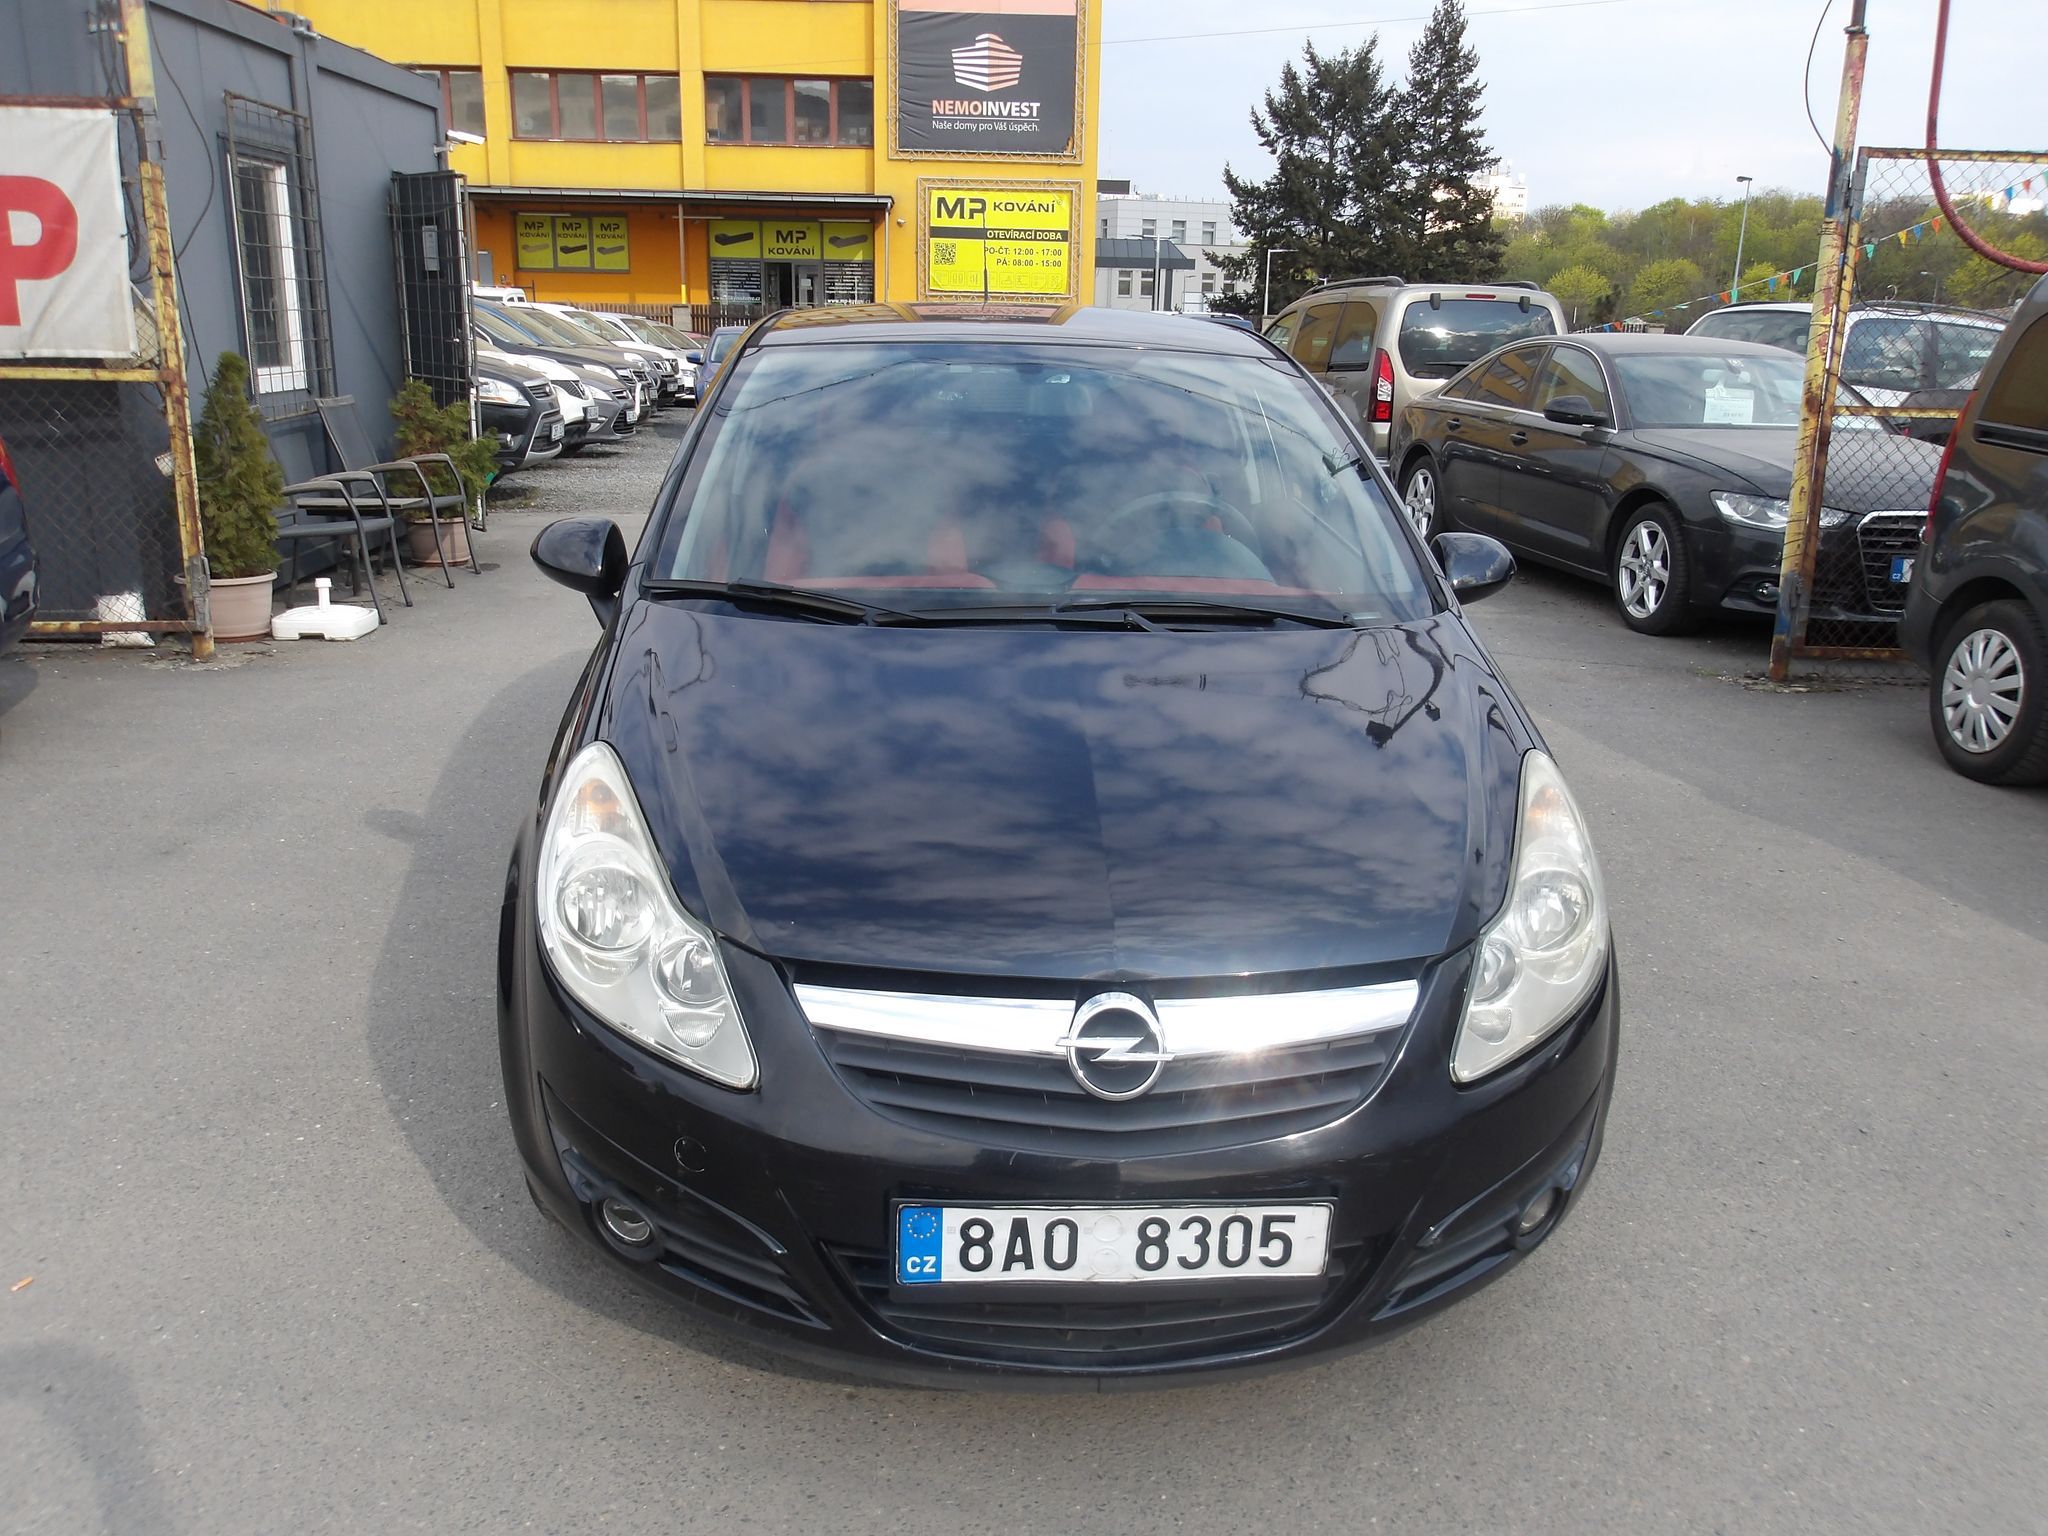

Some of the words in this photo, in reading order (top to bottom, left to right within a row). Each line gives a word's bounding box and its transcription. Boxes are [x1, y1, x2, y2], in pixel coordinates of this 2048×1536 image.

[932, 100, 1041, 117] NEMOINVEST
[932, 120, 953, 130] Naše
[953, 120, 978, 132] domy
[978, 123, 993, 132] pro
[993, 121, 1007, 131] Váš
[1008, 121, 1040, 133] úspěch.
[936, 196, 987, 220] MP
[993, 199, 1056, 213] KOVÁNÍ
[524, 221, 545, 231] MP
[562, 222, 583, 232] MP
[600, 223, 621, 233] MP
[775, 230, 807, 244] MP
[986, 229, 1035, 240] OTEVÍRACÍ
[1036, 232, 1063, 241] DOBA
[767, 246, 815, 256] KOVÁNÍ
[984, 246, 1011, 256] PO-ČT:
[1013, 248, 1034, 256] 12:00
[1041, 248, 1063, 257] 17:00
[996, 257, 1011, 267] PÁ:
[1012, 259, 1034, 267] 08:00
[1041, 259, 1062, 268] 15:00
[958, 1216, 1080, 1272] 8A0
[1134, 1213, 1297, 1272] 8305
[906, 1255, 937, 1274] CZ
